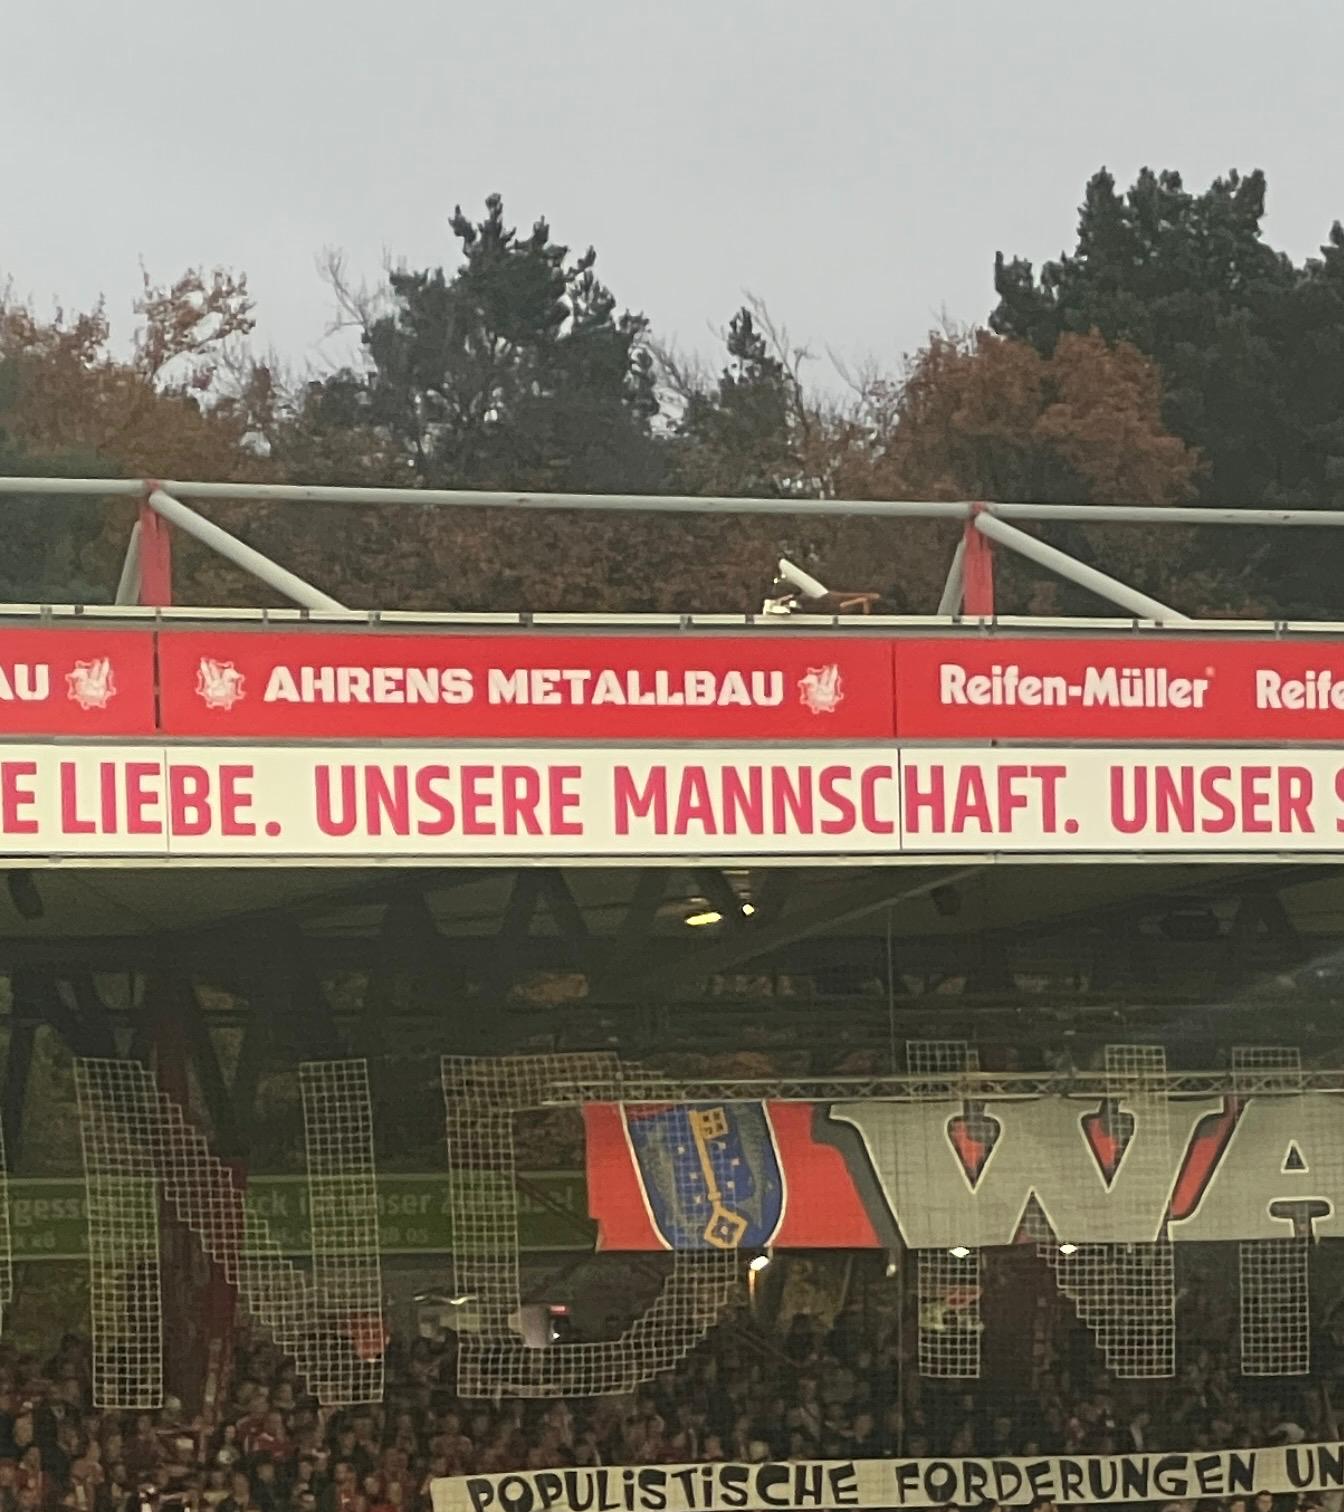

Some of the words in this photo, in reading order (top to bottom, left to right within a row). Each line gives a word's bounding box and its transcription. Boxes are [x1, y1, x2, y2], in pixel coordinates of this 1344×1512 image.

[264, 665, 473, 706] AHRENS
[488, 668, 784, 709] METALLBAU
[940, 664, 1208, 710] Reifen-Müller
[60, 762, 282, 837] LIEBE.
[315, 764, 583, 837] UNSERE
[614, 764, 1079, 837] MANNSCHAFT.
[1109, 765, 1314, 834] UNSER
[895, 1452, 1257, 1502] FORDERUNGEN
